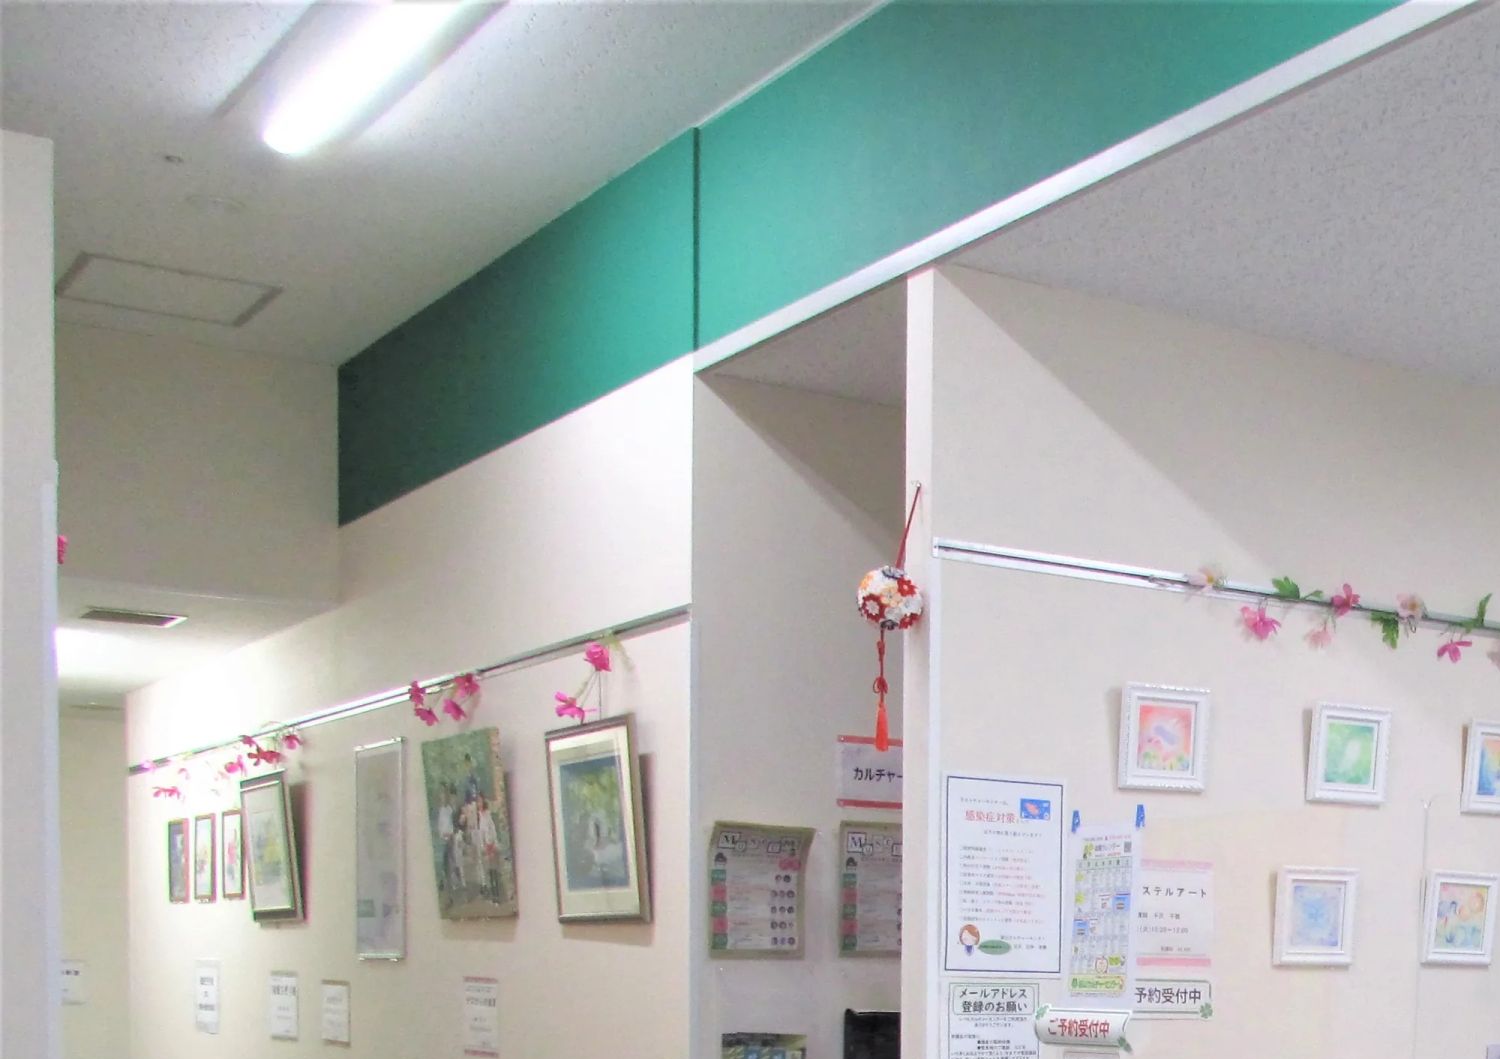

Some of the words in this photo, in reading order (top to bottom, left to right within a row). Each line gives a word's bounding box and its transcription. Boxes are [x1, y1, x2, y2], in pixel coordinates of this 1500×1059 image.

[965, 810, 1016, 824] 感染症対策
[959, 988, 1028, 999] メールアドレス
[1134, 987, 1202, 1005] 予約受付中
[961, 1000, 1028, 1014] 登録のお願い
[1047, 1017, 1111, 1039] ご予約受付中
